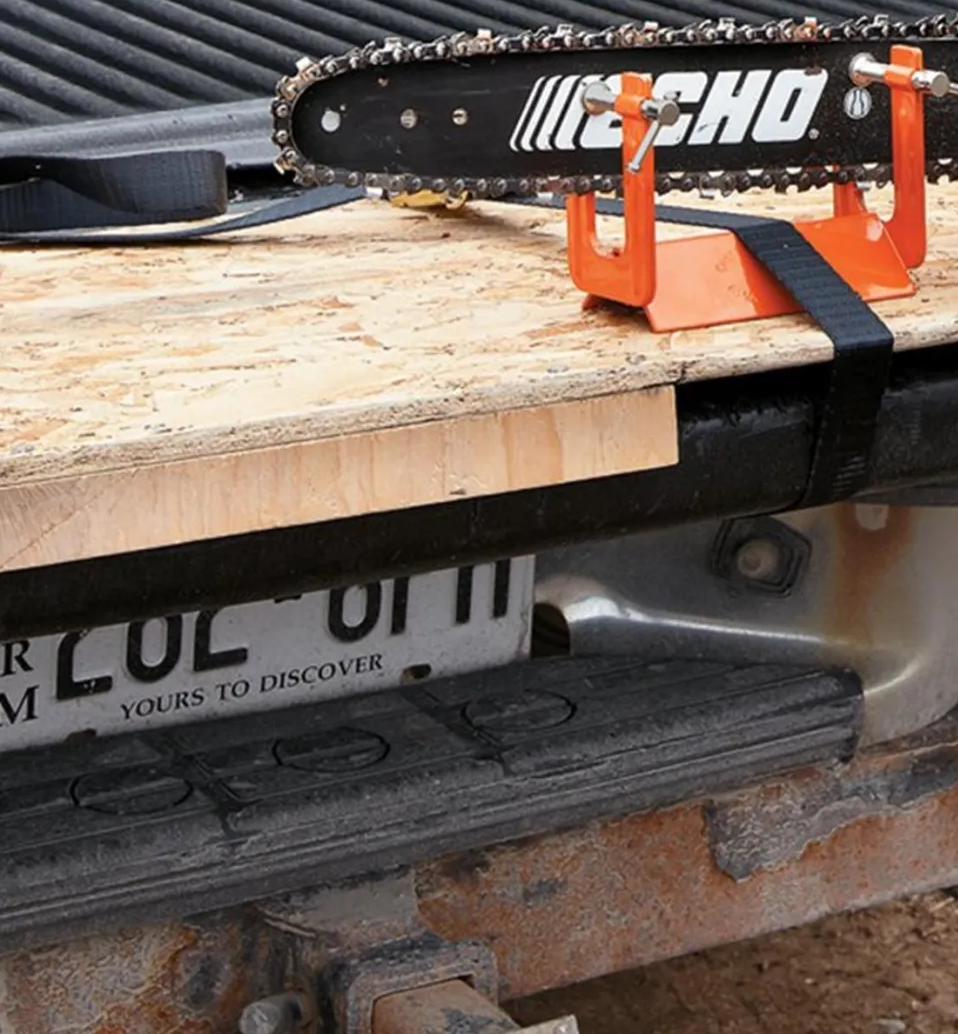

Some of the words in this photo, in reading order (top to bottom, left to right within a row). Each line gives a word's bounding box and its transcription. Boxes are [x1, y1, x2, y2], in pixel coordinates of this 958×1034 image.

[120, 687, 205, 720] YOURS
[215, 678, 250, 701] TO
[259, 653, 384, 694] DISCOVER
